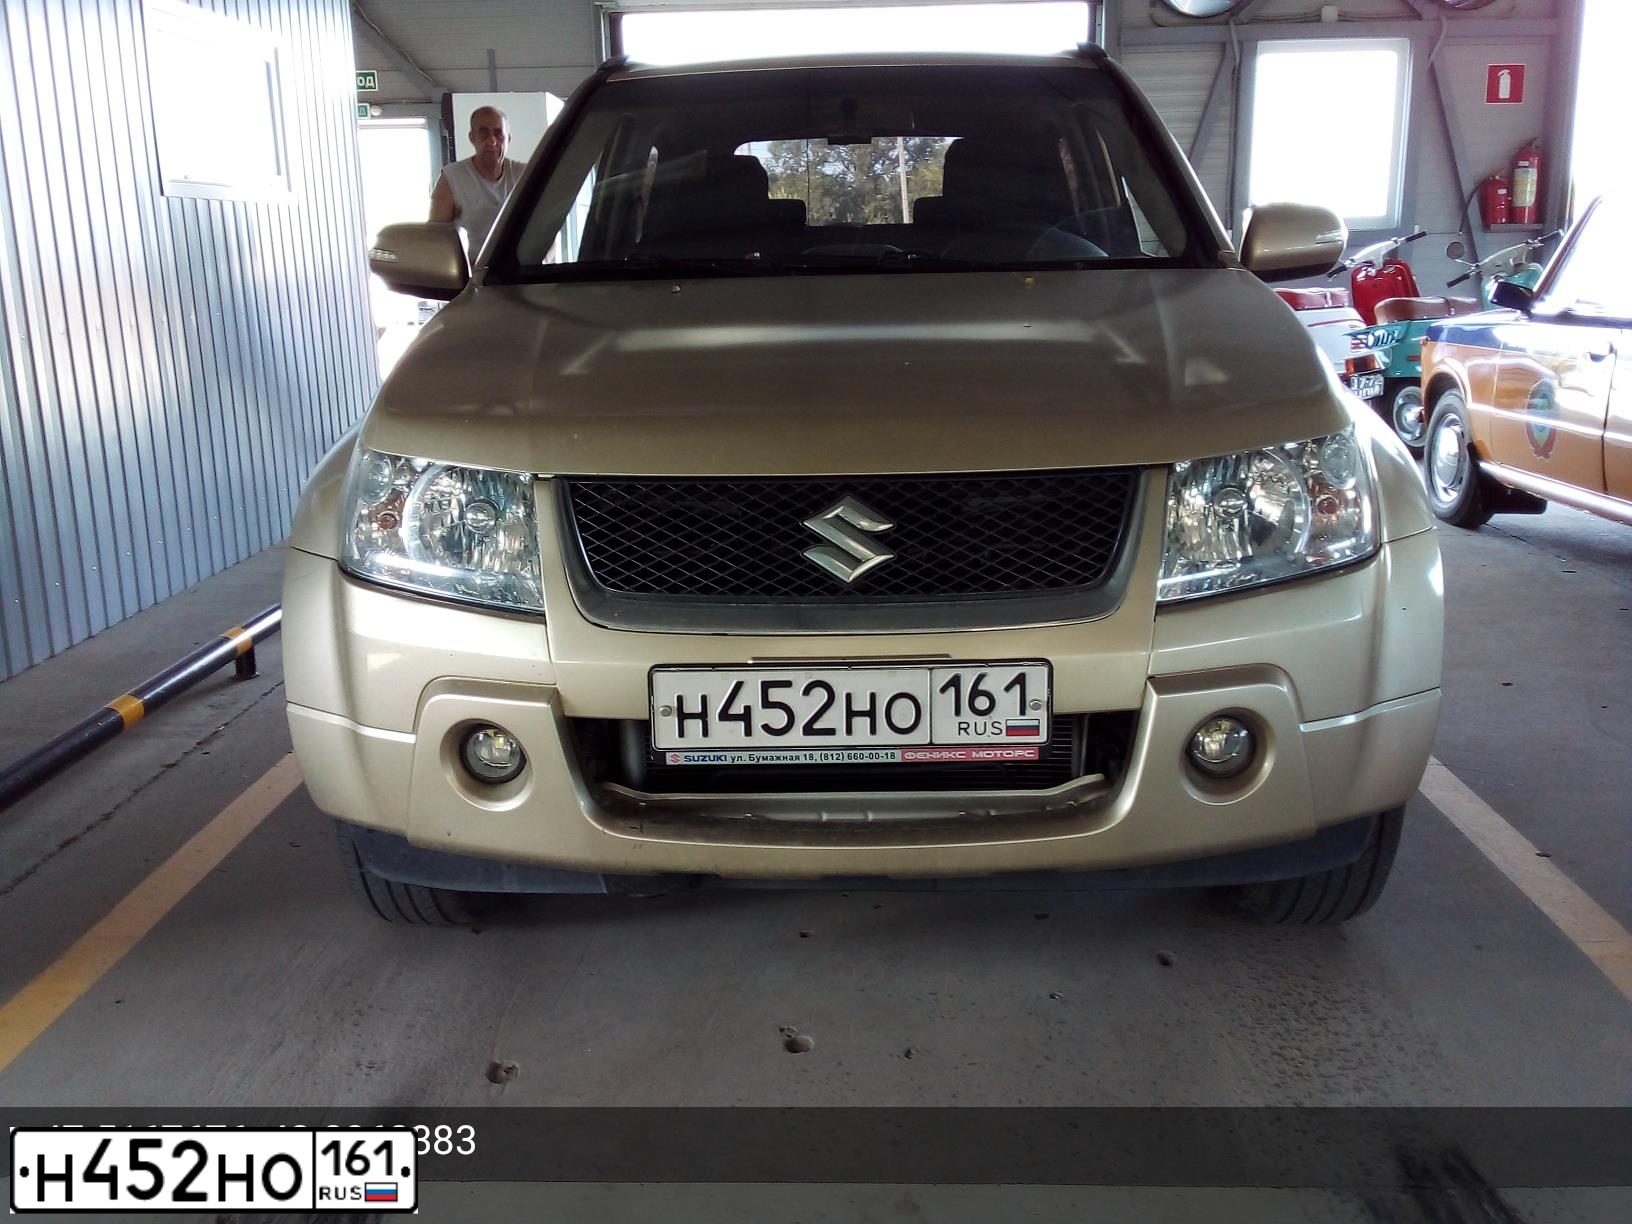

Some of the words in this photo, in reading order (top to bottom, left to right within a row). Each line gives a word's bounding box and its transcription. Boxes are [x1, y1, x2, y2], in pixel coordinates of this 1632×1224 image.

[356, 76, 375, 88] ОД
[938, 672, 1028, 717] 161
[957, 721, 1004, 737] RUS
[684, 754, 728, 763] SUZUKI
[730, 755, 746, 763] ул.
[749, 753, 800, 763] Бумажная
[820, 752, 845, 762] (812)
[847, 752, 896, 761] 660-00-18
[904, 751, 966, 760] ФЕНИКС
[972, 750, 1035, 758] МОТОРС
